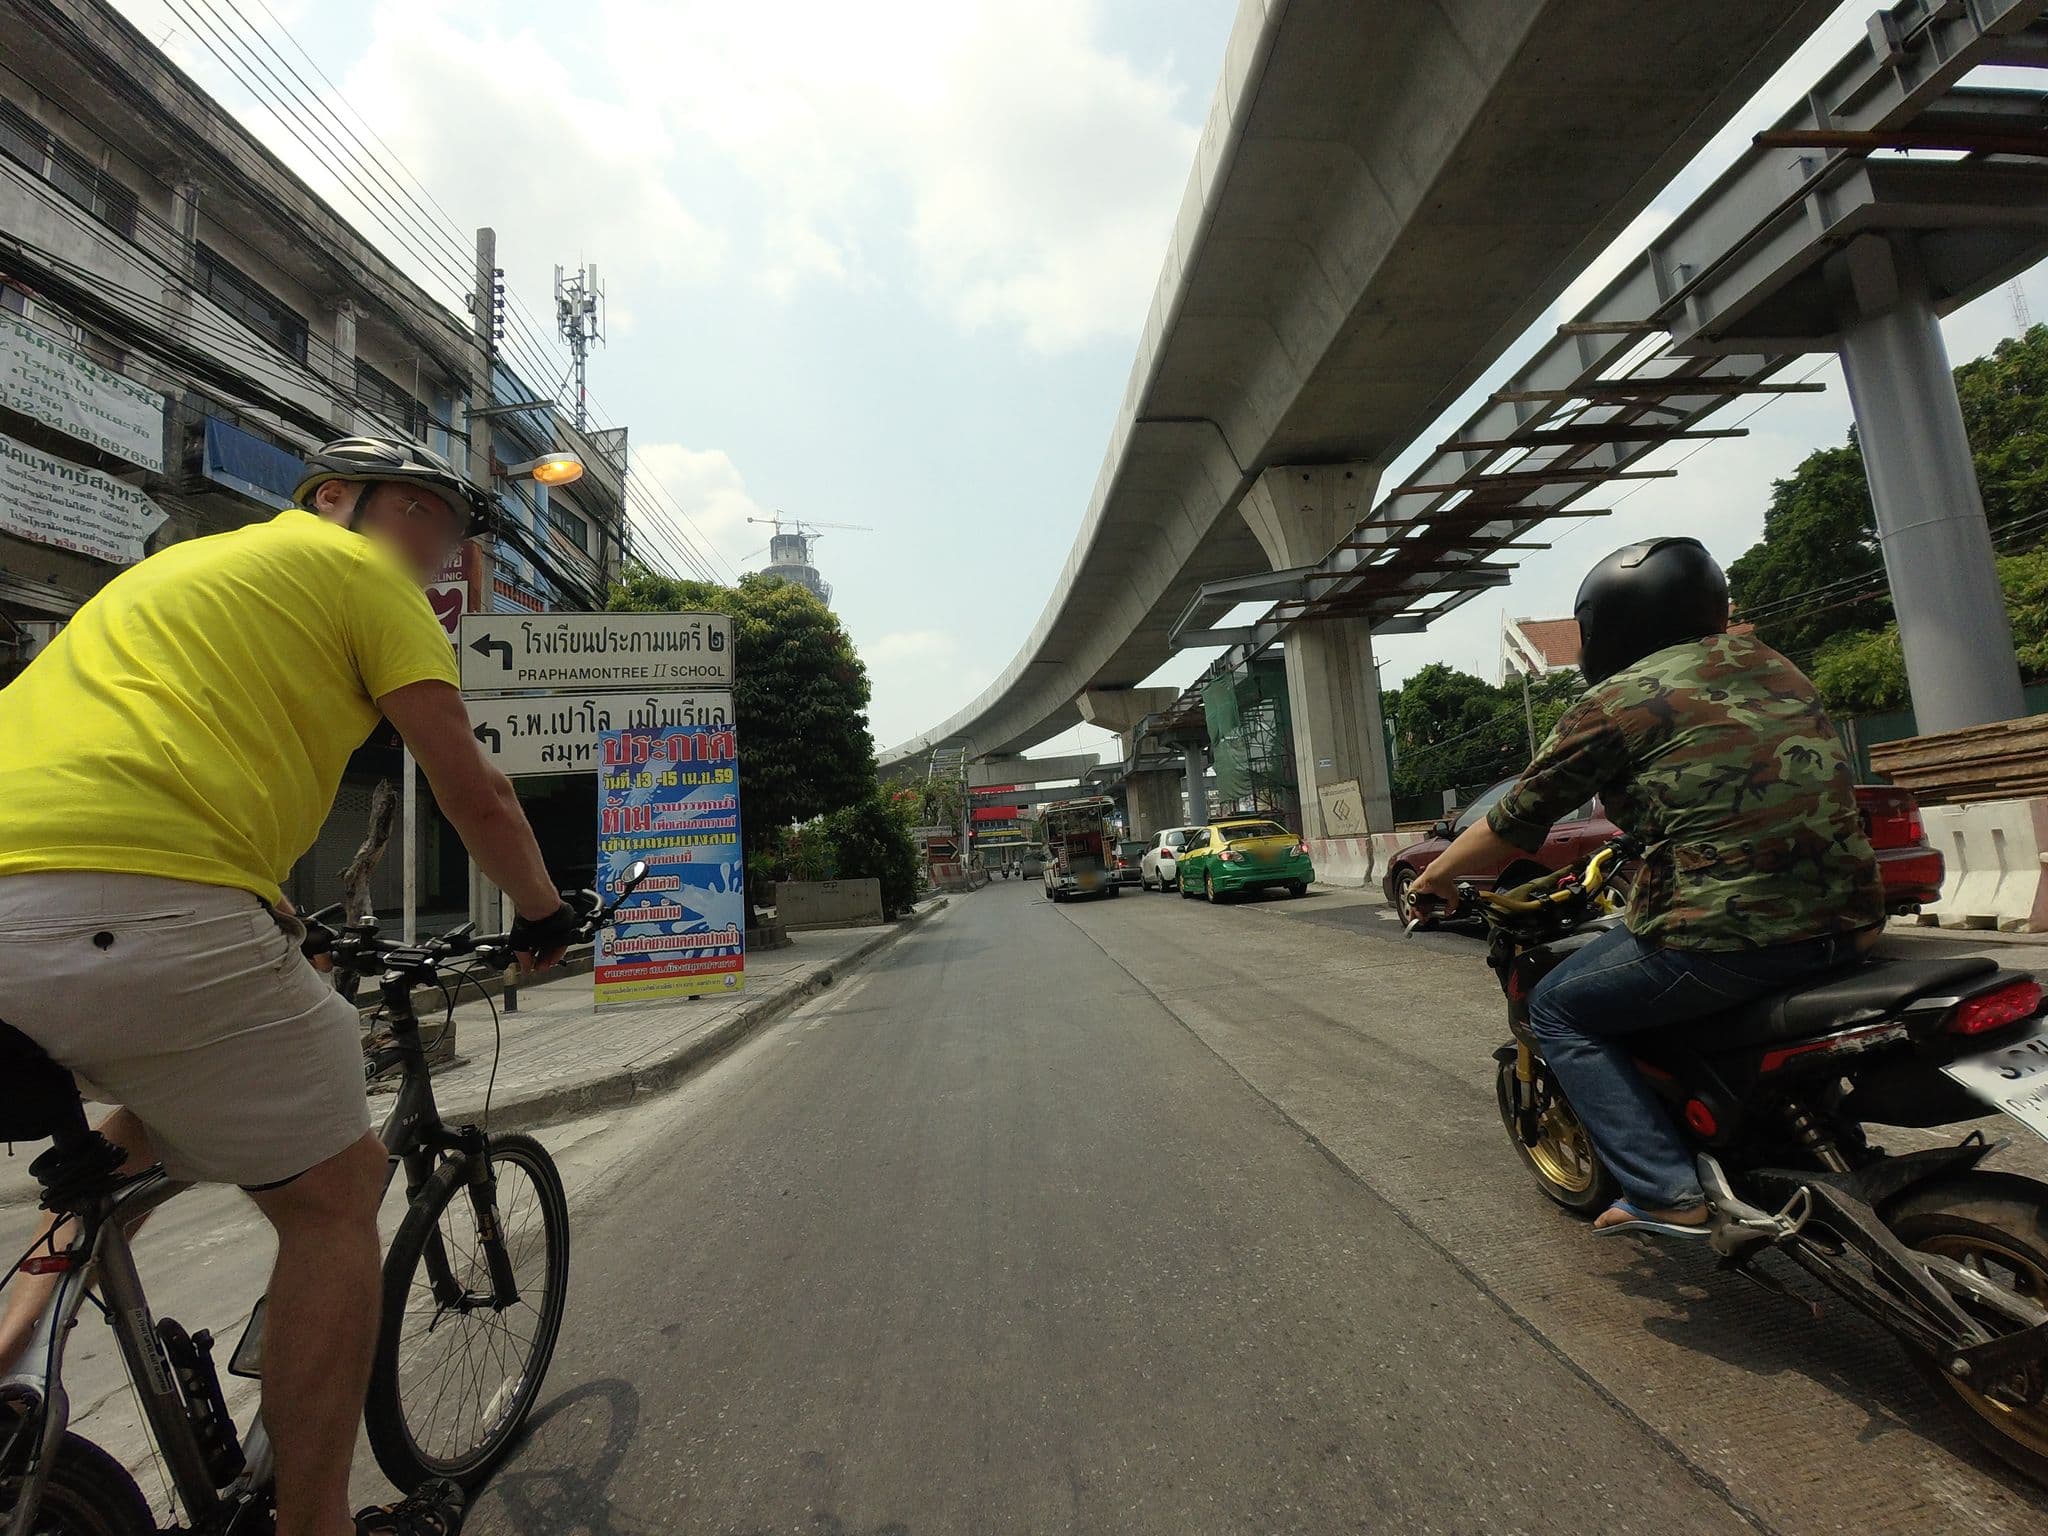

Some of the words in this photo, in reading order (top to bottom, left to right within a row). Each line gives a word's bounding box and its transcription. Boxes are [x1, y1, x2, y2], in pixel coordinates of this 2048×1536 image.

[521, 621, 701, 655] โรงเรียนประภามนตรี
[707, 624, 725, 652] ๒
[518, 666, 649, 681] PRAPHAMONTREE
[652, 663, 669, 678] II
[671, 665, 725, 677] SCHOOL
[628, 697, 726, 730] เมโมเรียล
[602, 730, 736, 767] ประกาศ
[603, 770, 630, 791] วันที่
[635, 771, 653, 789] 13
[601, 795, 652, 835] ห้าม
